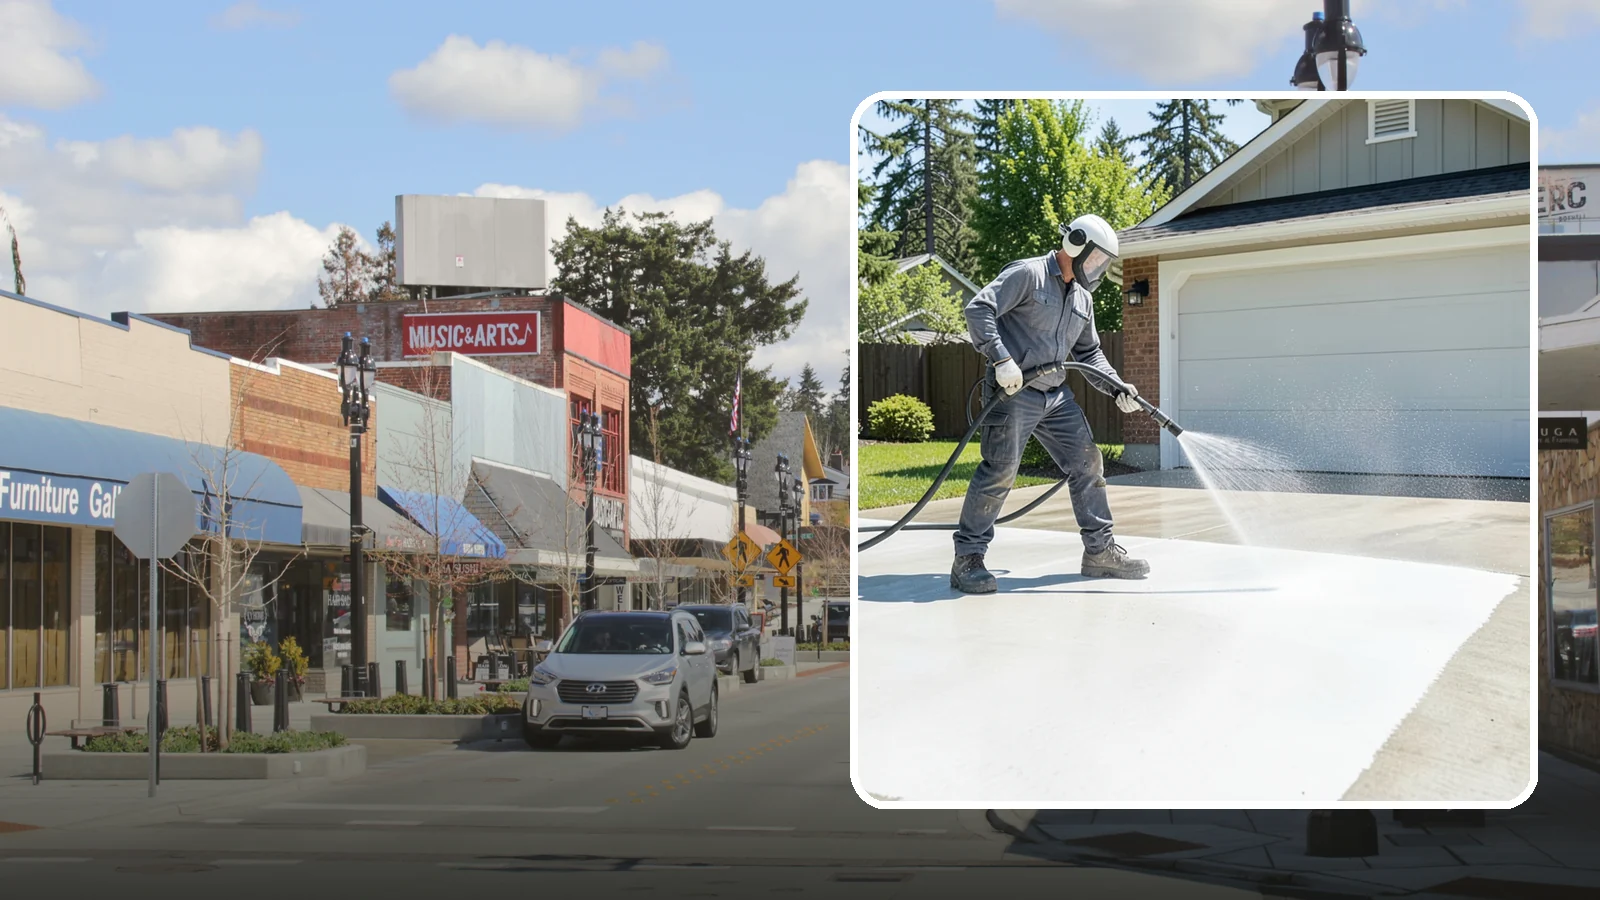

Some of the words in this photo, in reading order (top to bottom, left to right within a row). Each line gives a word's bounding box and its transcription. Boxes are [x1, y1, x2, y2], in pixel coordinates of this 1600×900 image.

[409, 323, 519, 349] MUSIC&ARTS
[0, 471, 79, 515] Furniture
[89, 482, 122, 519] Gal
